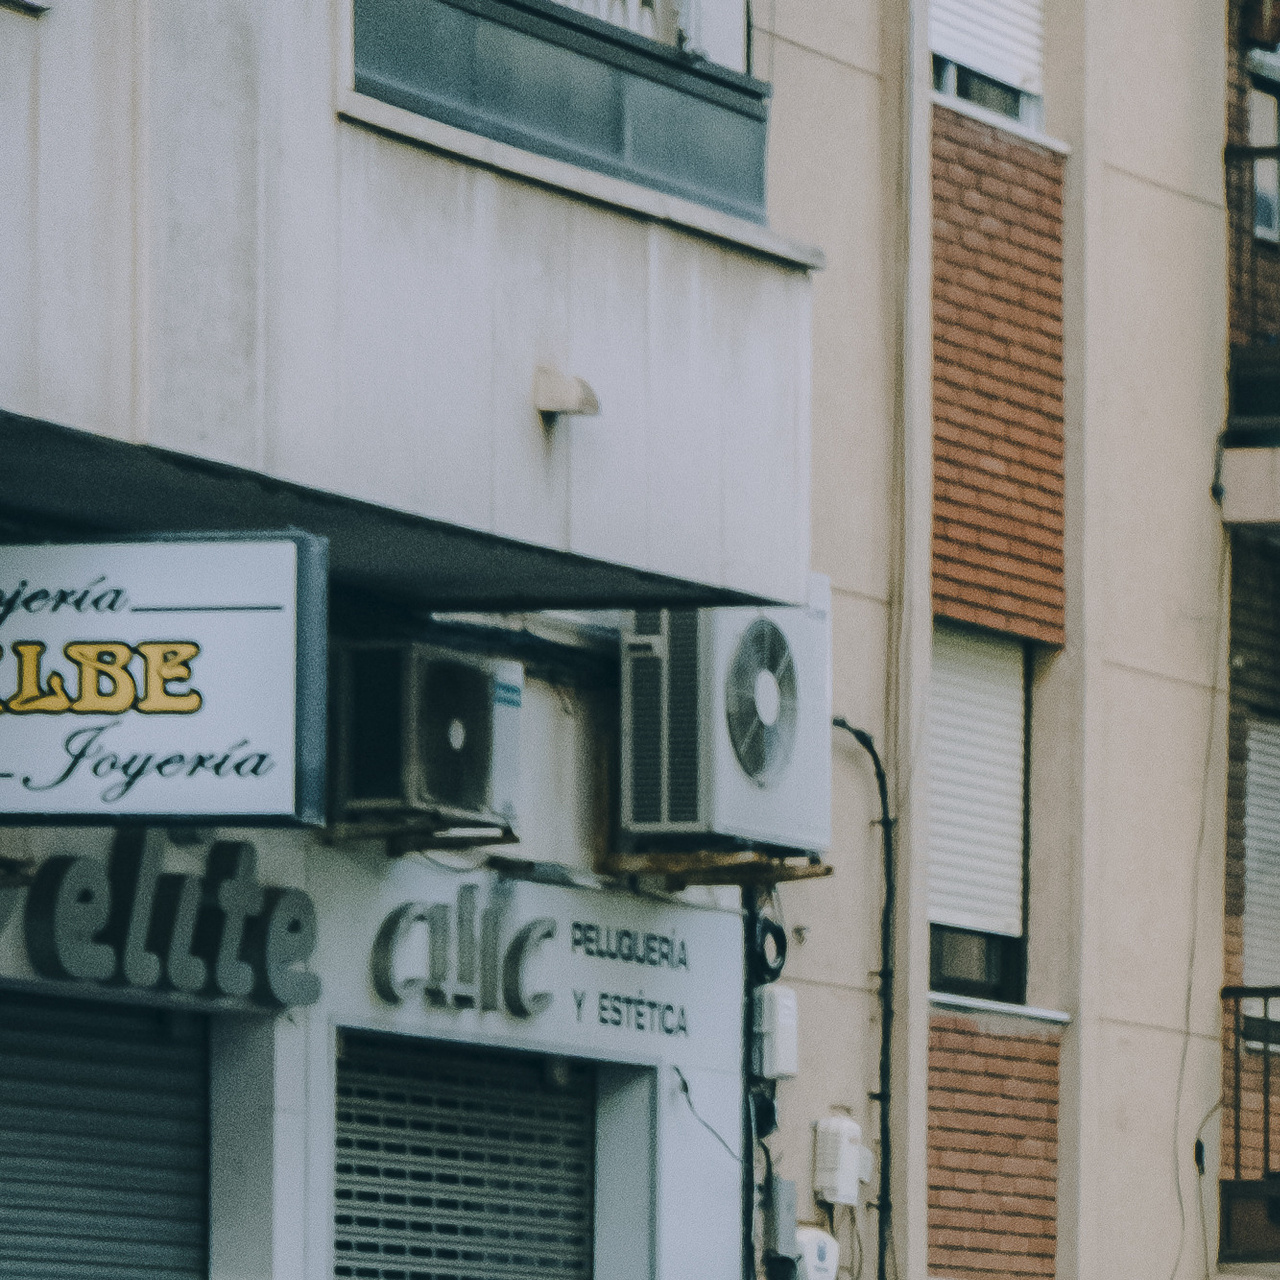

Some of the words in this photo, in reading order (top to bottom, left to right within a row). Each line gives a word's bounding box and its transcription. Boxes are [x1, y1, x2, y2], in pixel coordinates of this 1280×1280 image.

[0, 575, 130, 626] jería
[0, 639, 203, 716] LBE
[21, 719, 276, 803] Joyería
[0, 824, 321, 1007] elite
[572, 988, 587, 1023] Y
